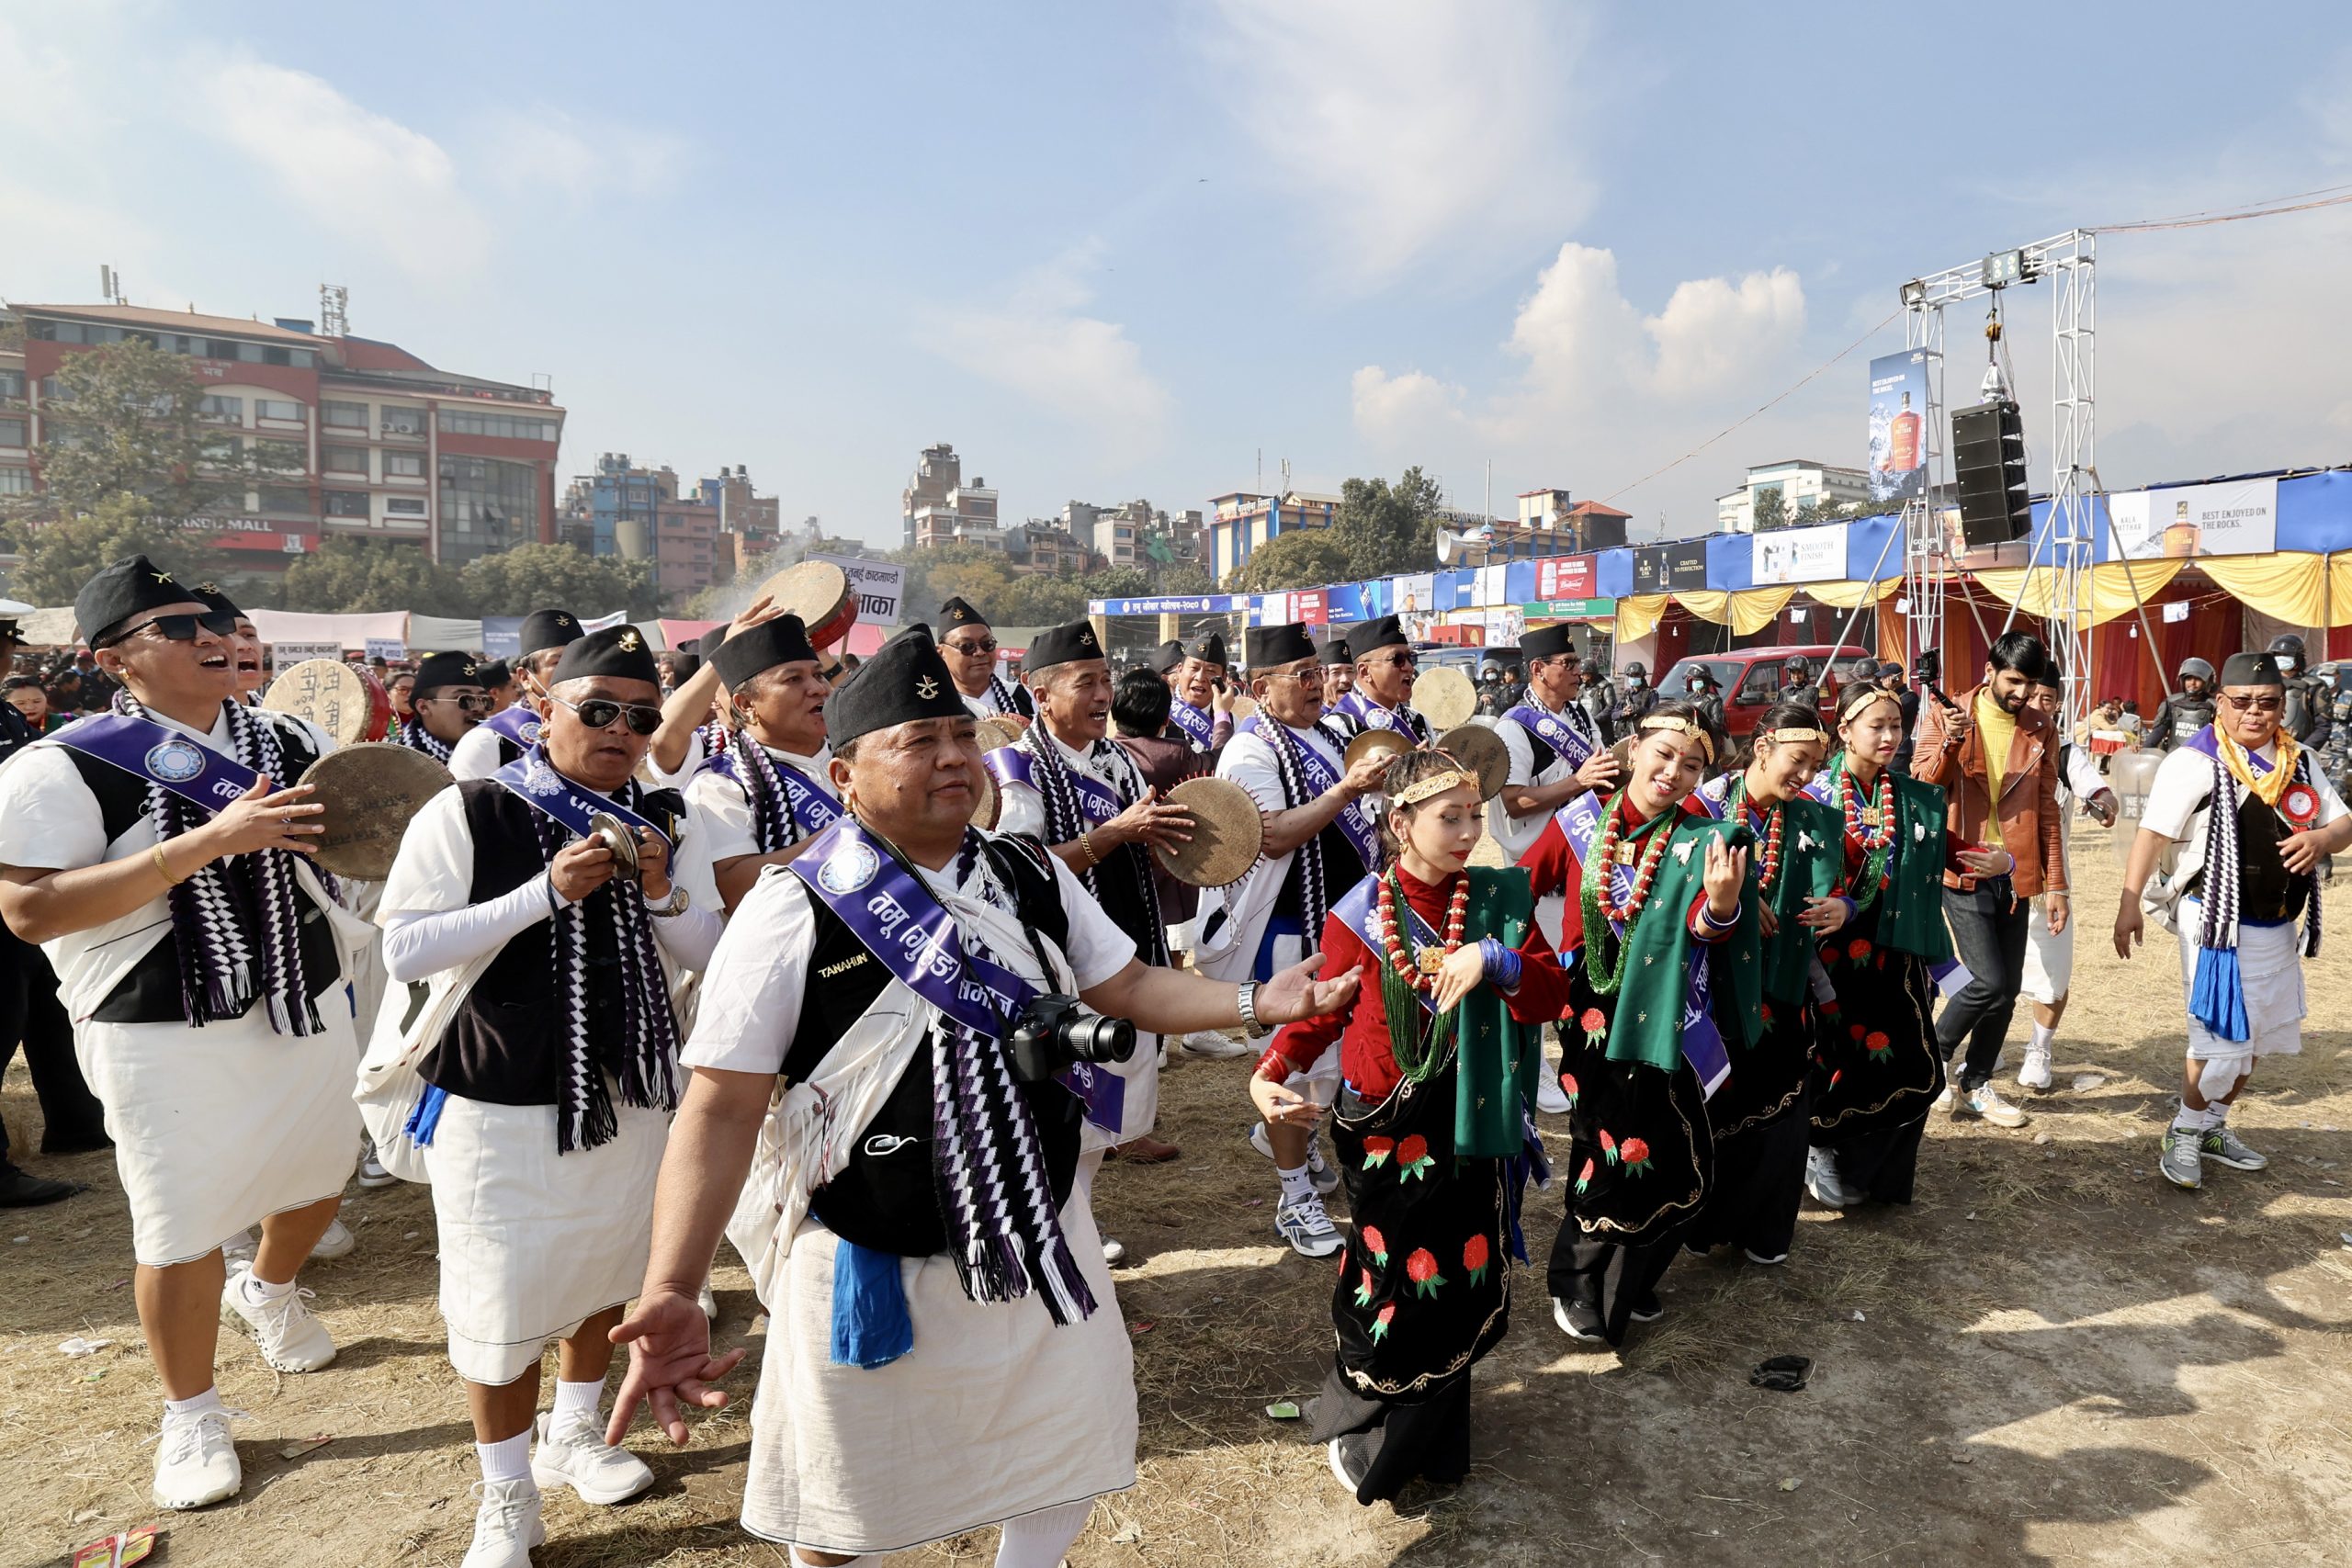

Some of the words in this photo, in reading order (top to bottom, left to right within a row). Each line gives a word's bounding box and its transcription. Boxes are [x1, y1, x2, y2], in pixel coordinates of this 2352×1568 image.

[1452, 512, 1498, 525] CORPORAION
[2202, 511, 2220, 521] BEST
[2222, 509, 2255, 519] ENJOYED
[2256, 506, 2267, 516] ON
[228, 520, 273, 532] MALL
[2202, 522, 2215, 530] THE
[2216, 520, 2243, 529] ROCKS.
[1801, 541, 1834, 552] SMOOTH
[1801, 551, 1824, 560] FINISH
[2177, 721, 2200, 731] NEPAL
[867, 890, 910, 940] तमू
[817, 952, 868, 978] TANAHUN
